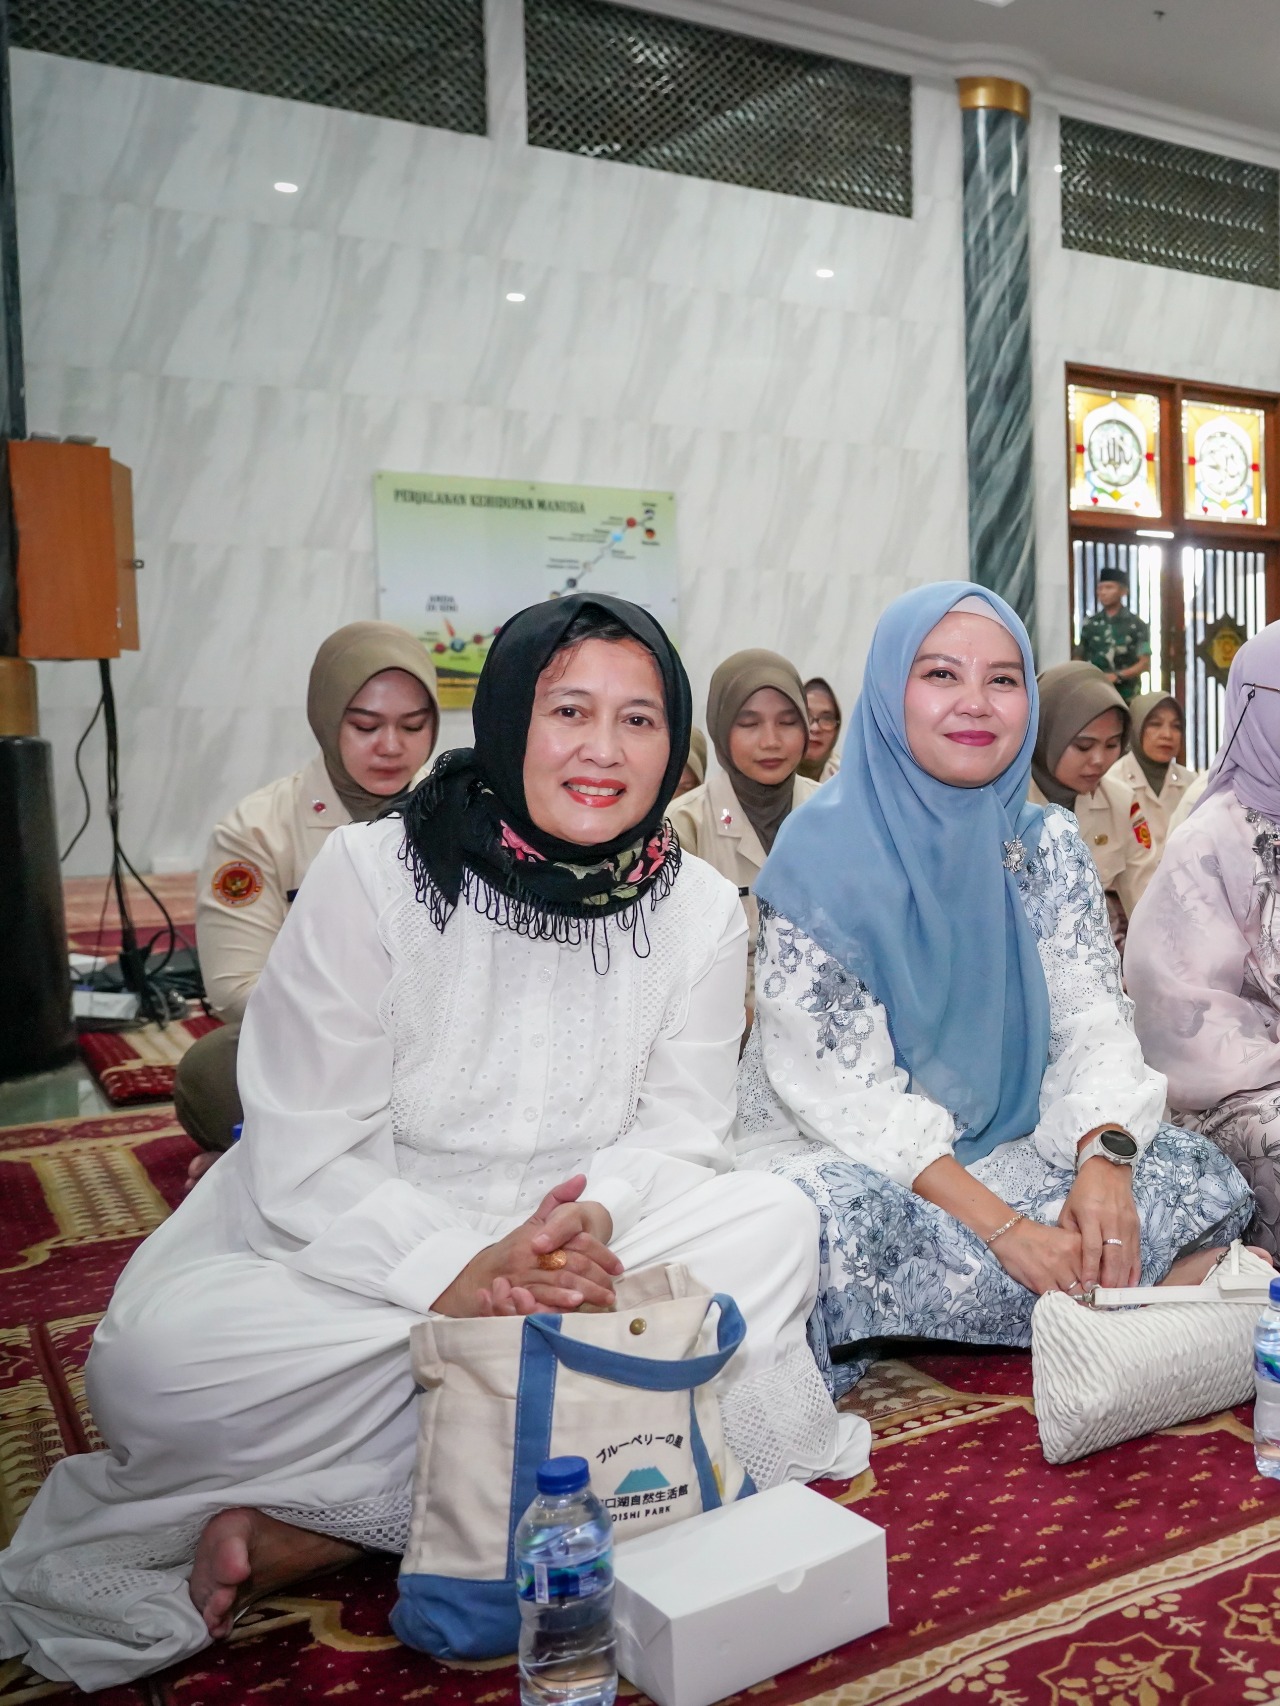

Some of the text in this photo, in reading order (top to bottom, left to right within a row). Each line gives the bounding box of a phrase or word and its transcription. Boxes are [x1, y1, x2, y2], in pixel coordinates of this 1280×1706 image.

[536, 498, 586, 514] MANUSIA
[596, 1433, 684, 1464] ブルーベリーの里
[601, 1484, 688, 1509] 口湖自然生活館
[645, 1505, 671, 1517] PARK
